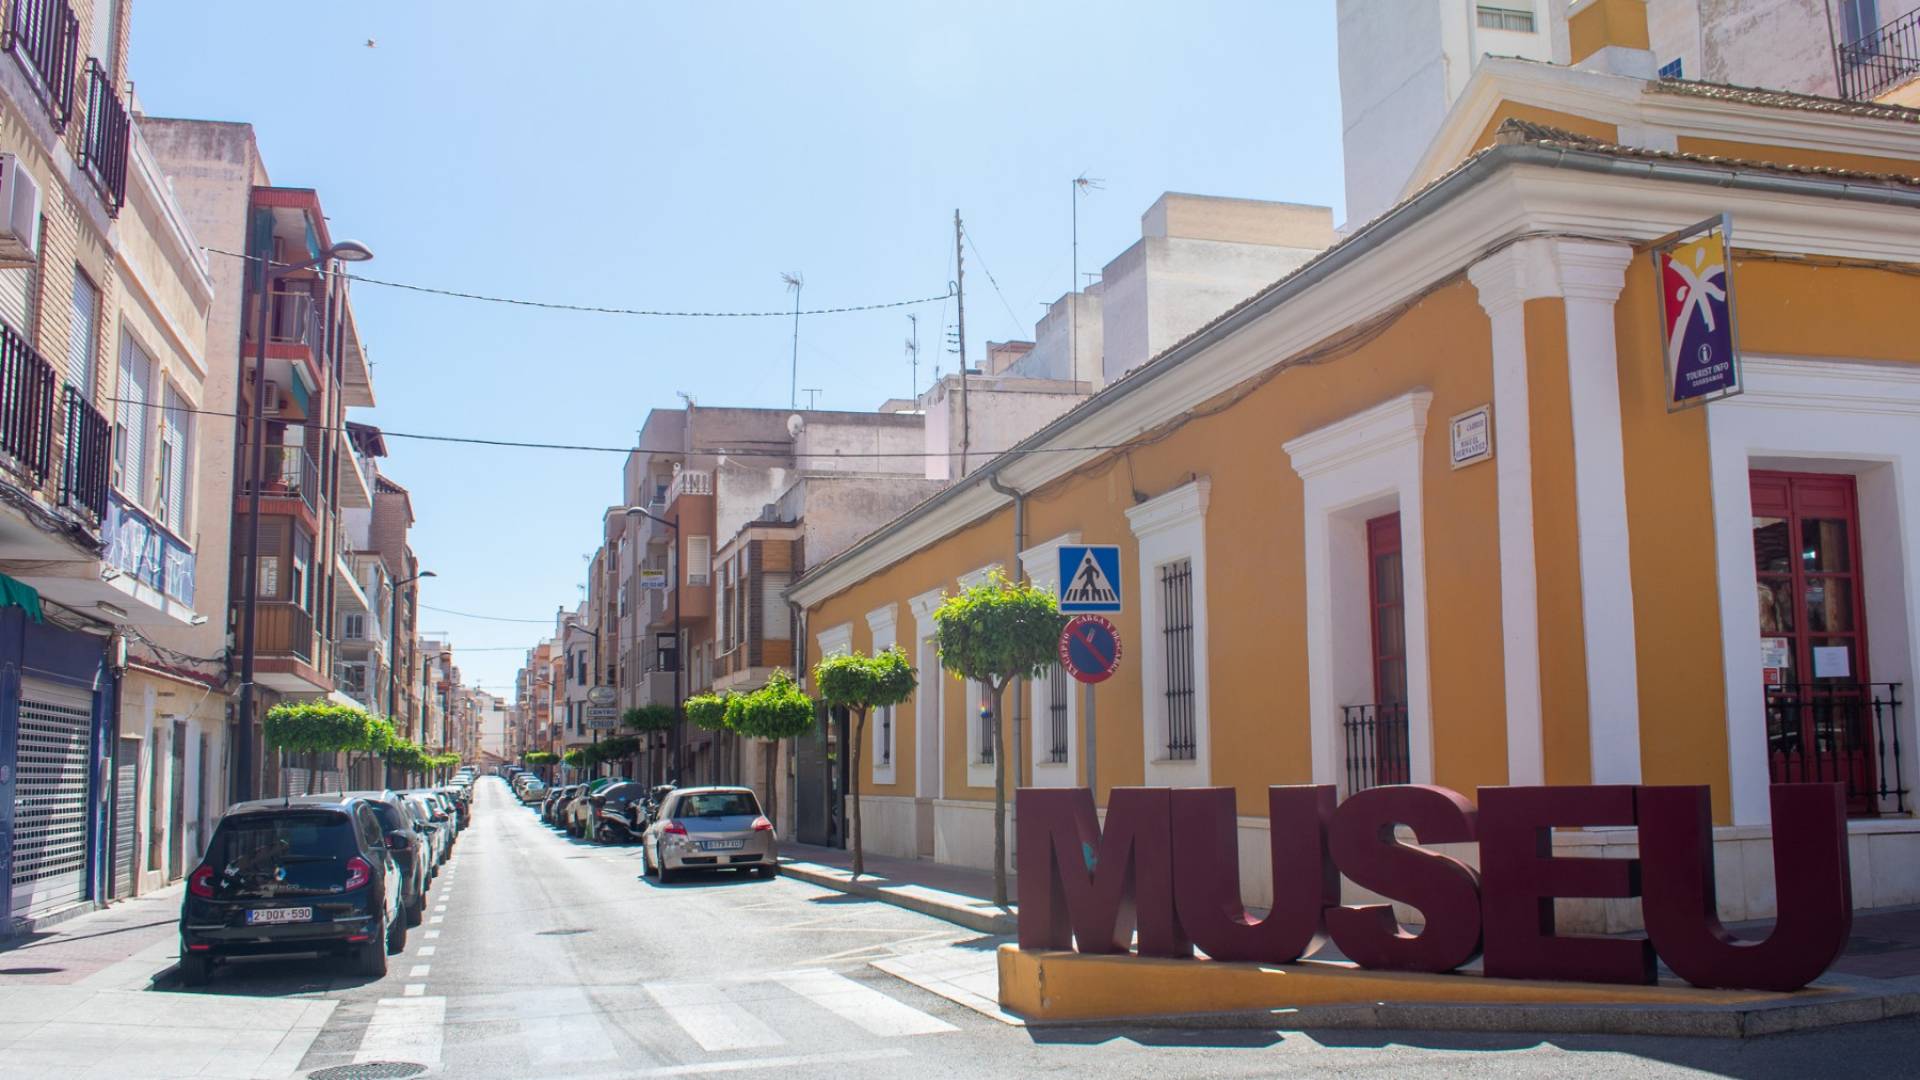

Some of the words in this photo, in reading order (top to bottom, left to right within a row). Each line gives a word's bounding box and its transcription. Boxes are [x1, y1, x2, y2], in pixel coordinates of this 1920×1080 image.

[1686, 366, 1712, 381] TOURIST
[1713, 361, 1729, 374] INFO
[1016, 782, 1852, 992] MUSEU
